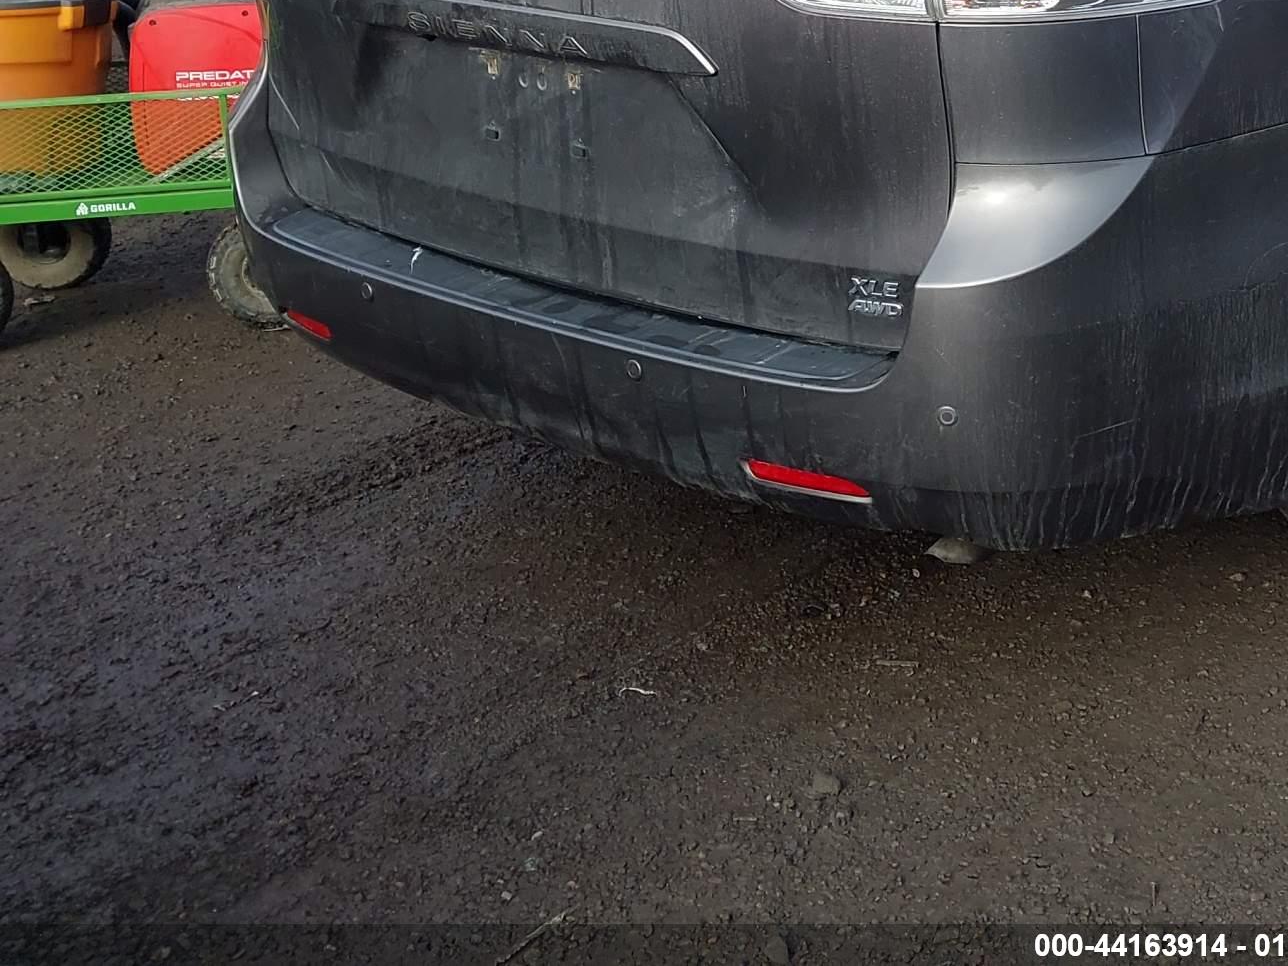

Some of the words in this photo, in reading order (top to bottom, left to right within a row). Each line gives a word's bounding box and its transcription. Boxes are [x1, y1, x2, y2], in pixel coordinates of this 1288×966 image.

[408, 11, 590, 57] SIENNA
[176, 70, 255, 81] PREDAT
[90, 202, 136, 213] GORILLA
[848, 277, 899, 297] XLE
[848, 299, 904, 316] AWD
